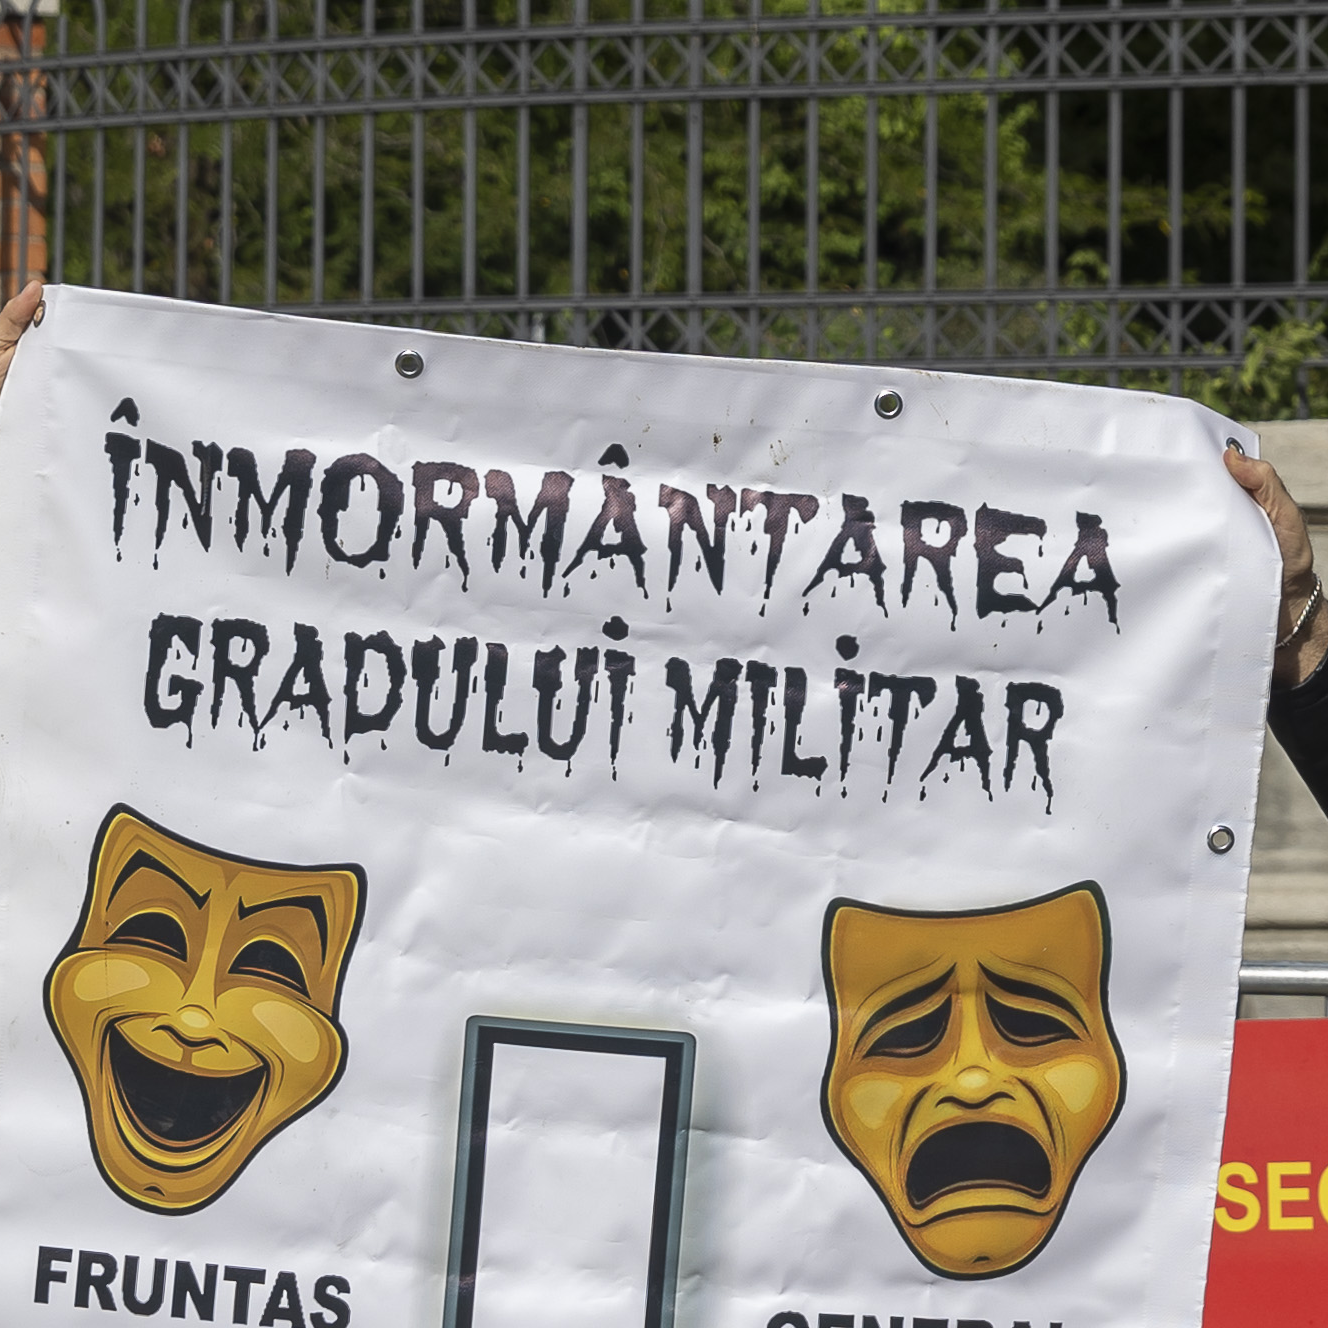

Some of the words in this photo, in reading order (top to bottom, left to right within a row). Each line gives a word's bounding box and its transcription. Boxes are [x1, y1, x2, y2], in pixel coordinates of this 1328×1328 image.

[104, 397, 1120, 634] ÎNMORMÂNTAREA
[144, 611, 635, 780] GRADULUI
[665, 634, 1064, 814] MILITAR
